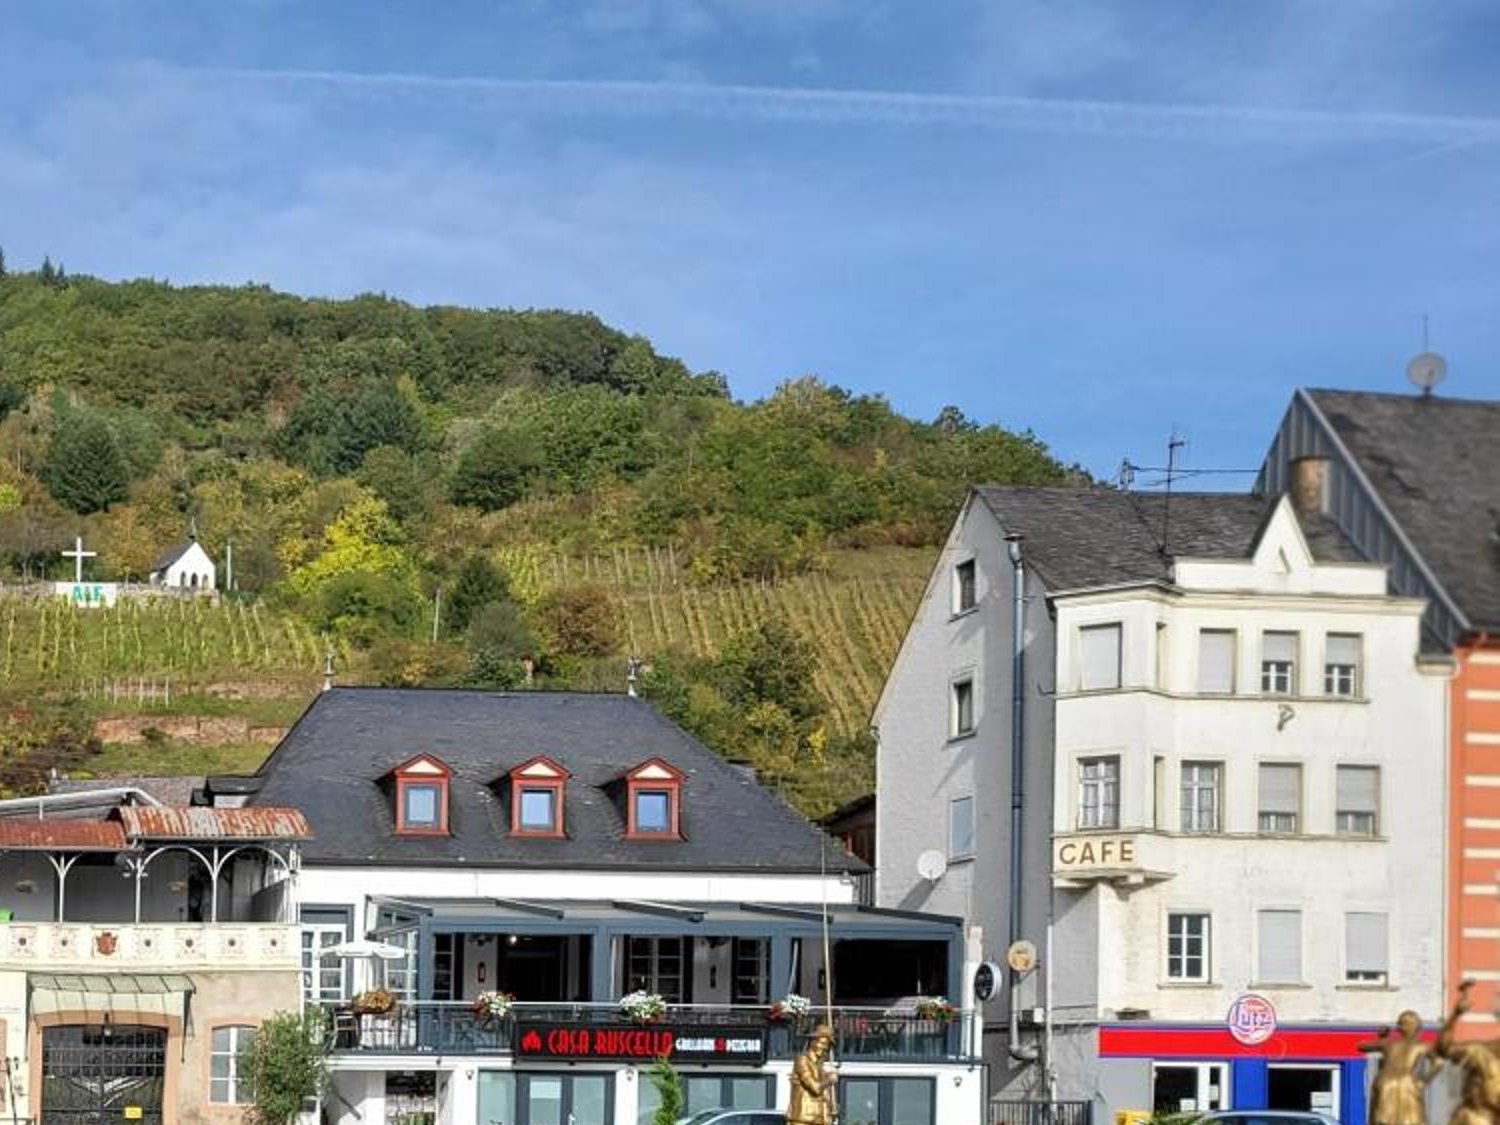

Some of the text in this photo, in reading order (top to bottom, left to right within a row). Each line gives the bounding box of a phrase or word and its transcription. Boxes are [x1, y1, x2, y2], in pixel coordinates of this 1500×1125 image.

[1059, 840, 1133, 864] CAFE
[547, 1029, 589, 1055] CASA
[594, 1030, 673, 1057] RUSCELLO
